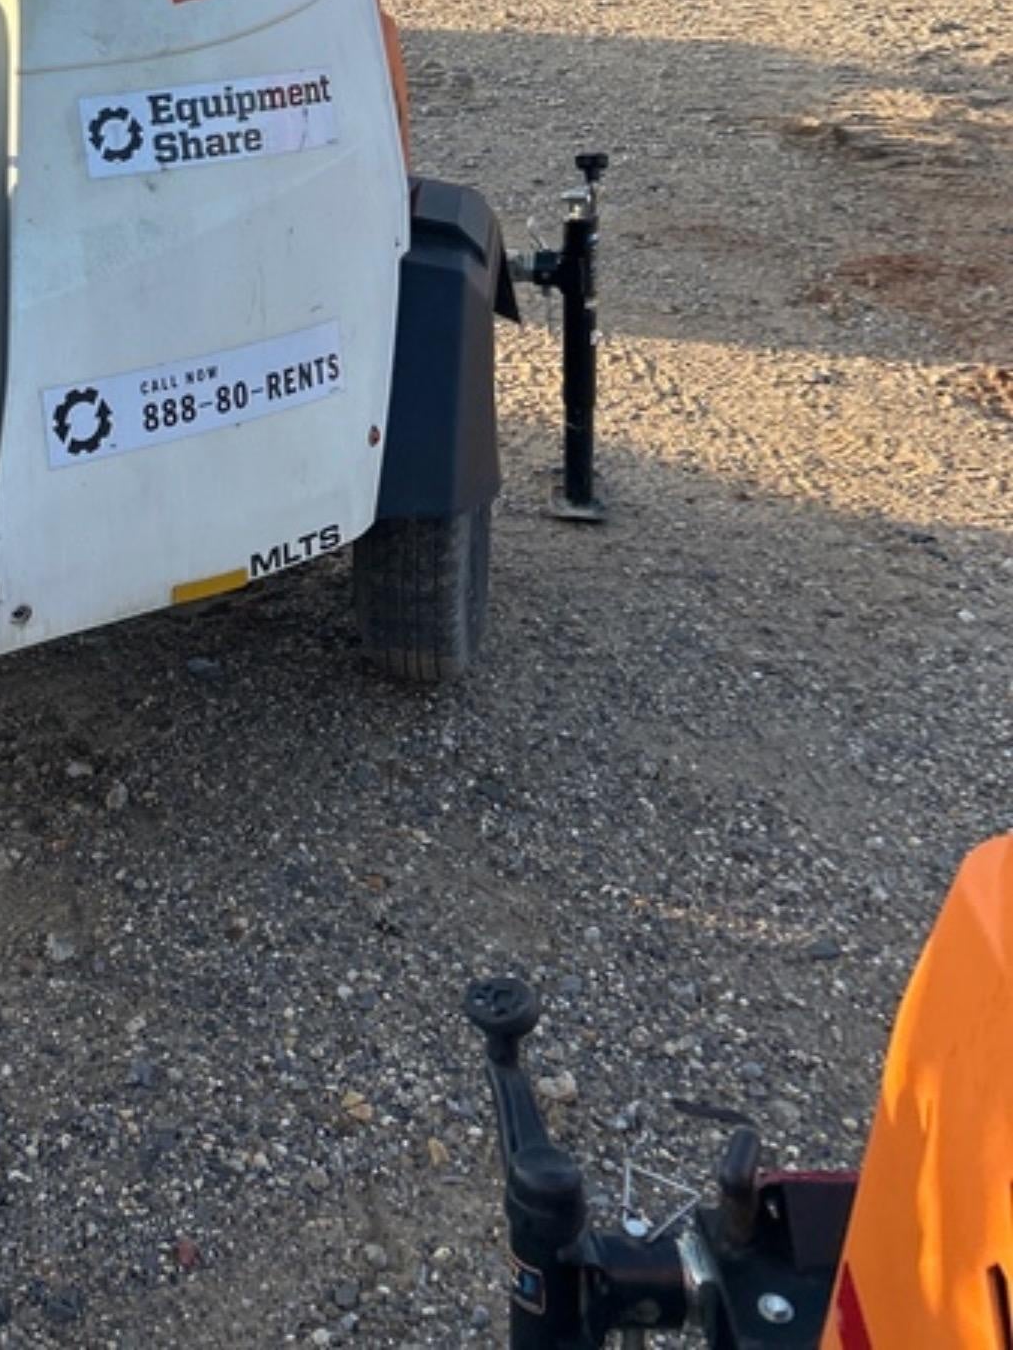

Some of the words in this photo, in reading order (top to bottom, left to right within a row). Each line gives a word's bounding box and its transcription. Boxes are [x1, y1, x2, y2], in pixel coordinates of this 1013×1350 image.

[147, 74, 332, 129] Equipment
[153, 128, 263, 163] Share
[140, 376, 178, 396] CALL
[185, 366, 219, 385] NOW
[143, 353, 340, 433] 888-80-RENTS
[250, 524, 340, 577] MLTS
